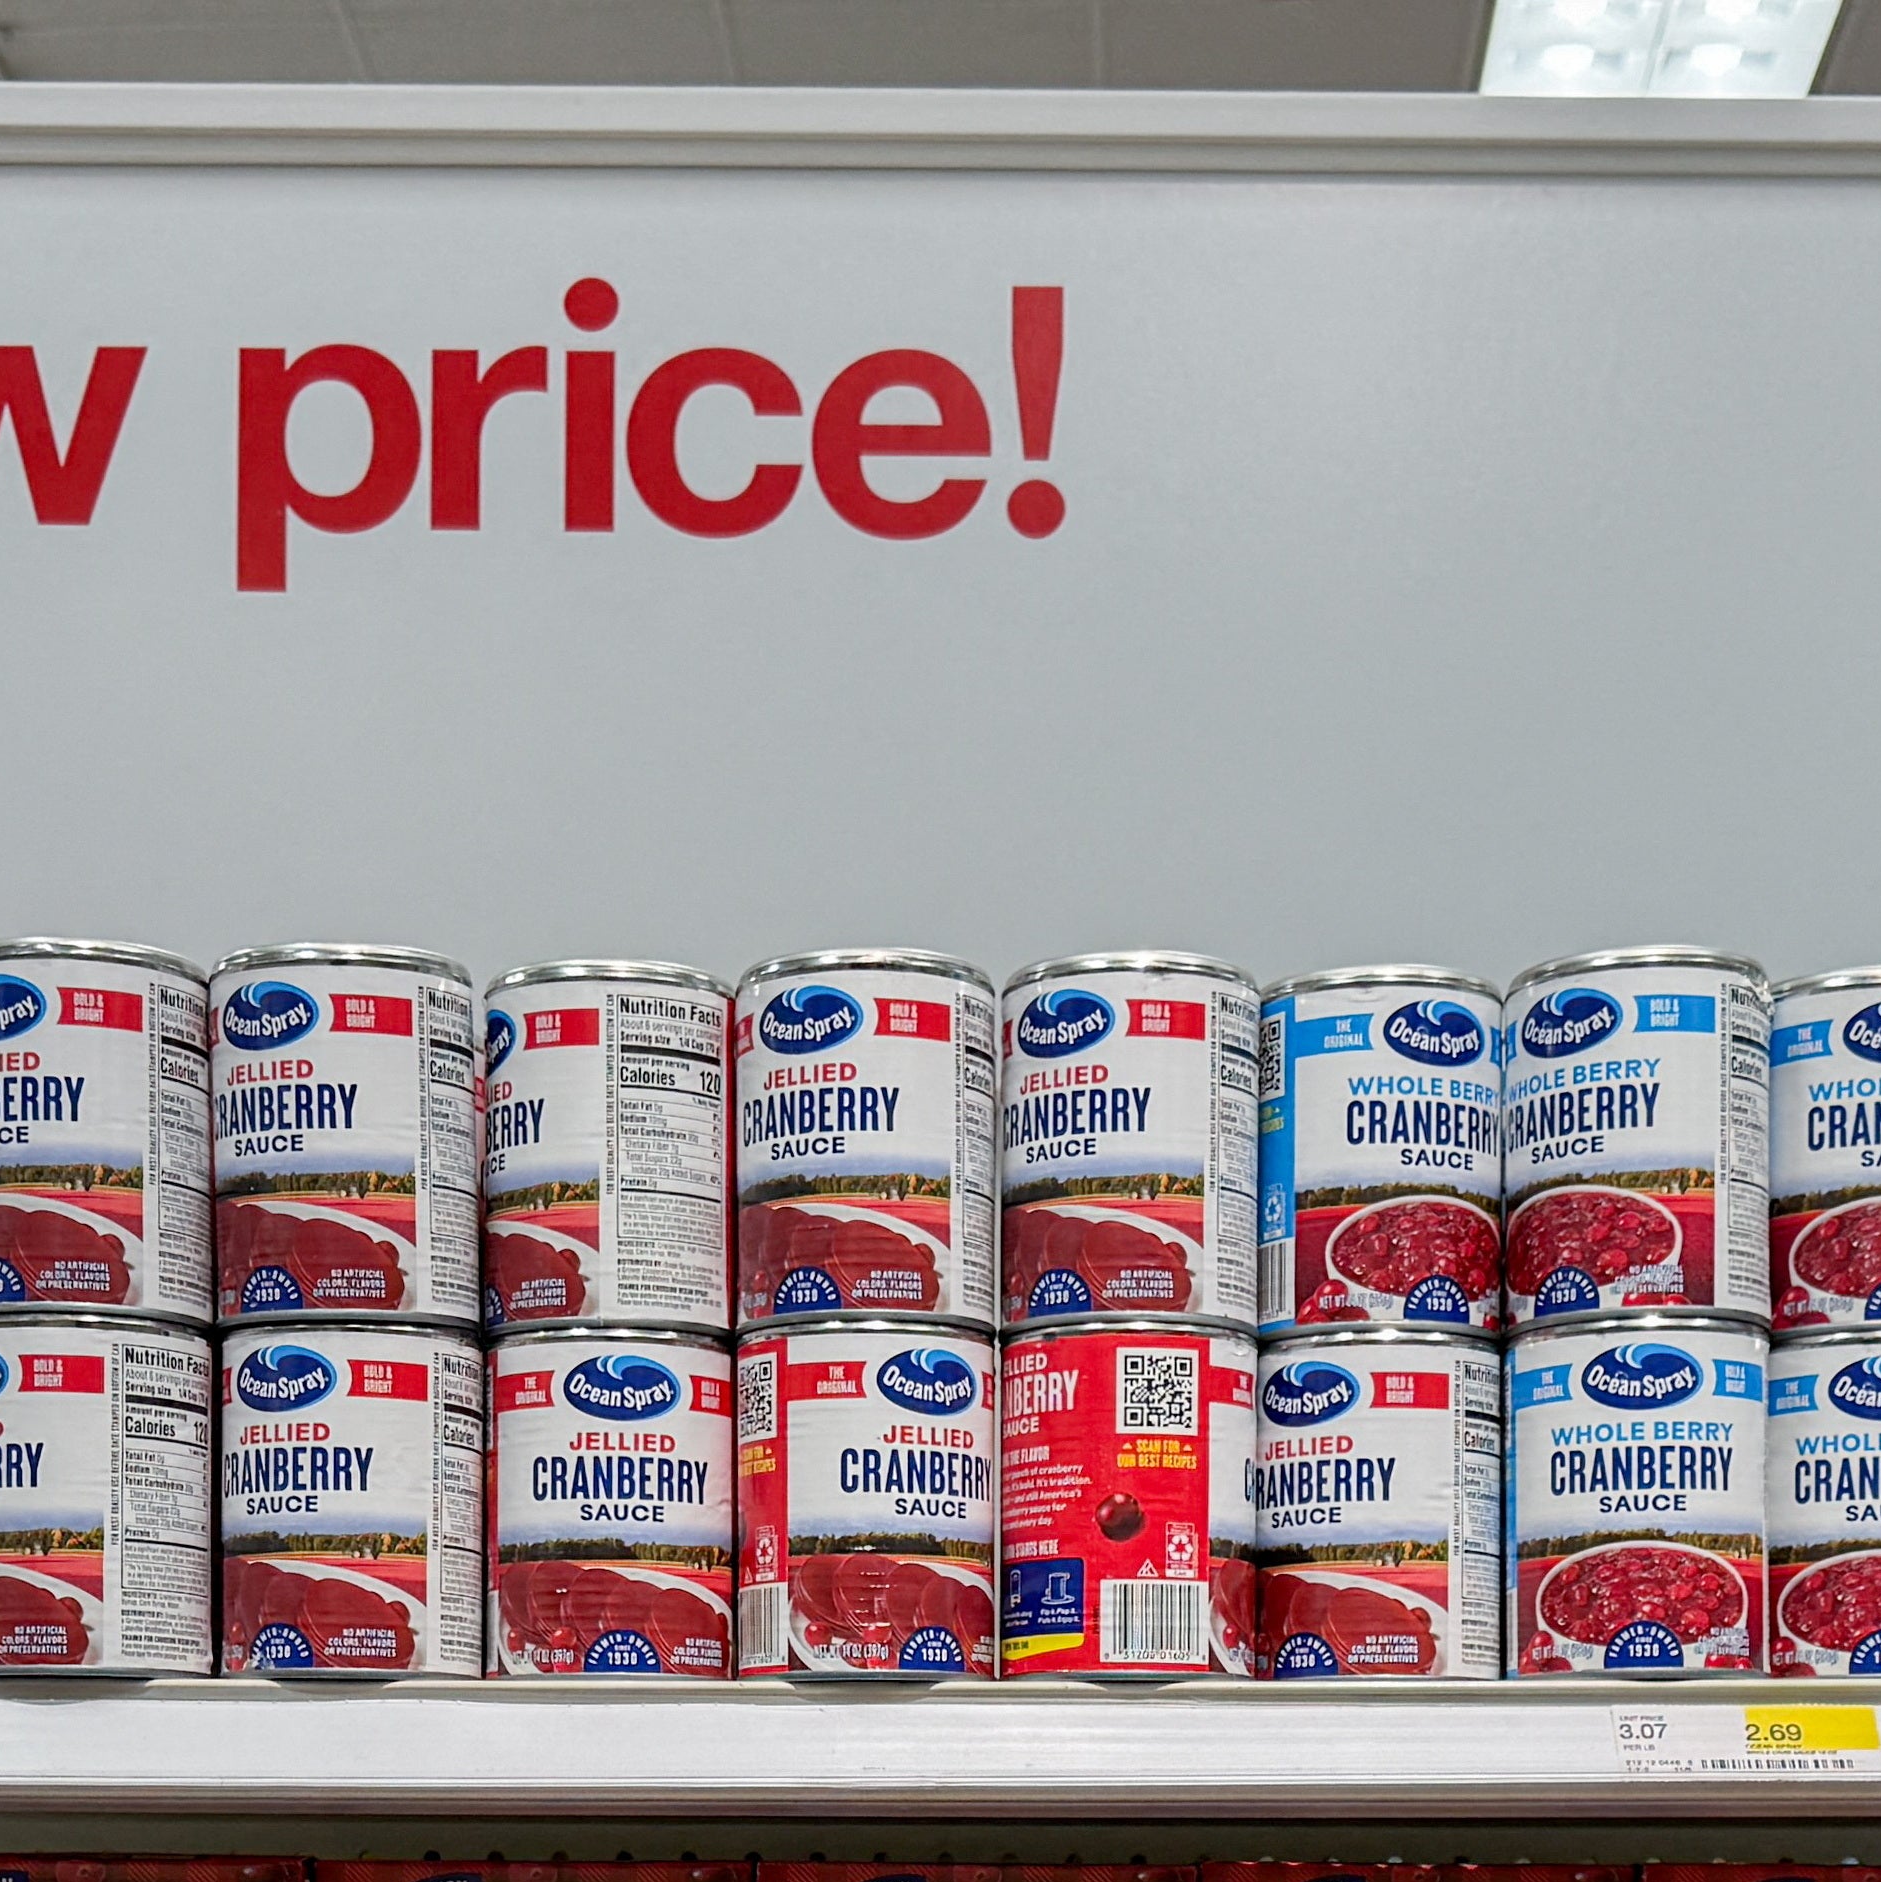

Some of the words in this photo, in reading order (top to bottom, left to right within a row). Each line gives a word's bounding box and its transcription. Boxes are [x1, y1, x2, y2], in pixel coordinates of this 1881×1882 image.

[236, 272, 1068, 595] price!
[620, 998, 685, 1019] Nutrition
[690, 1006, 720, 1027] Facts
[621, 1032, 652, 1045] Serving
[620, 1066, 675, 1086] Calories
[700, 1070, 720, 1095] 120
[569, 1374, 621, 1408] Ocean
[570, 1432, 676, 1452] JELLIED
[1551, 1422, 1645, 1446] WHOLE
[1654, 1422, 1733, 1442] BERRY
[532, 1456, 708, 1504] CRANBERRY
[1550, 1445, 1733, 1496] CRANBERRY
[580, 1504, 664, 1522] SAUCE
[1599, 1494, 1687, 1512] SAUCE
[607, 1652, 637, 1665] 1930
[1628, 1644, 1659, 1657] 1930
[1619, 1724, 1668, 1740] 3.07
[1745, 1724, 1802, 1741] 2.69
